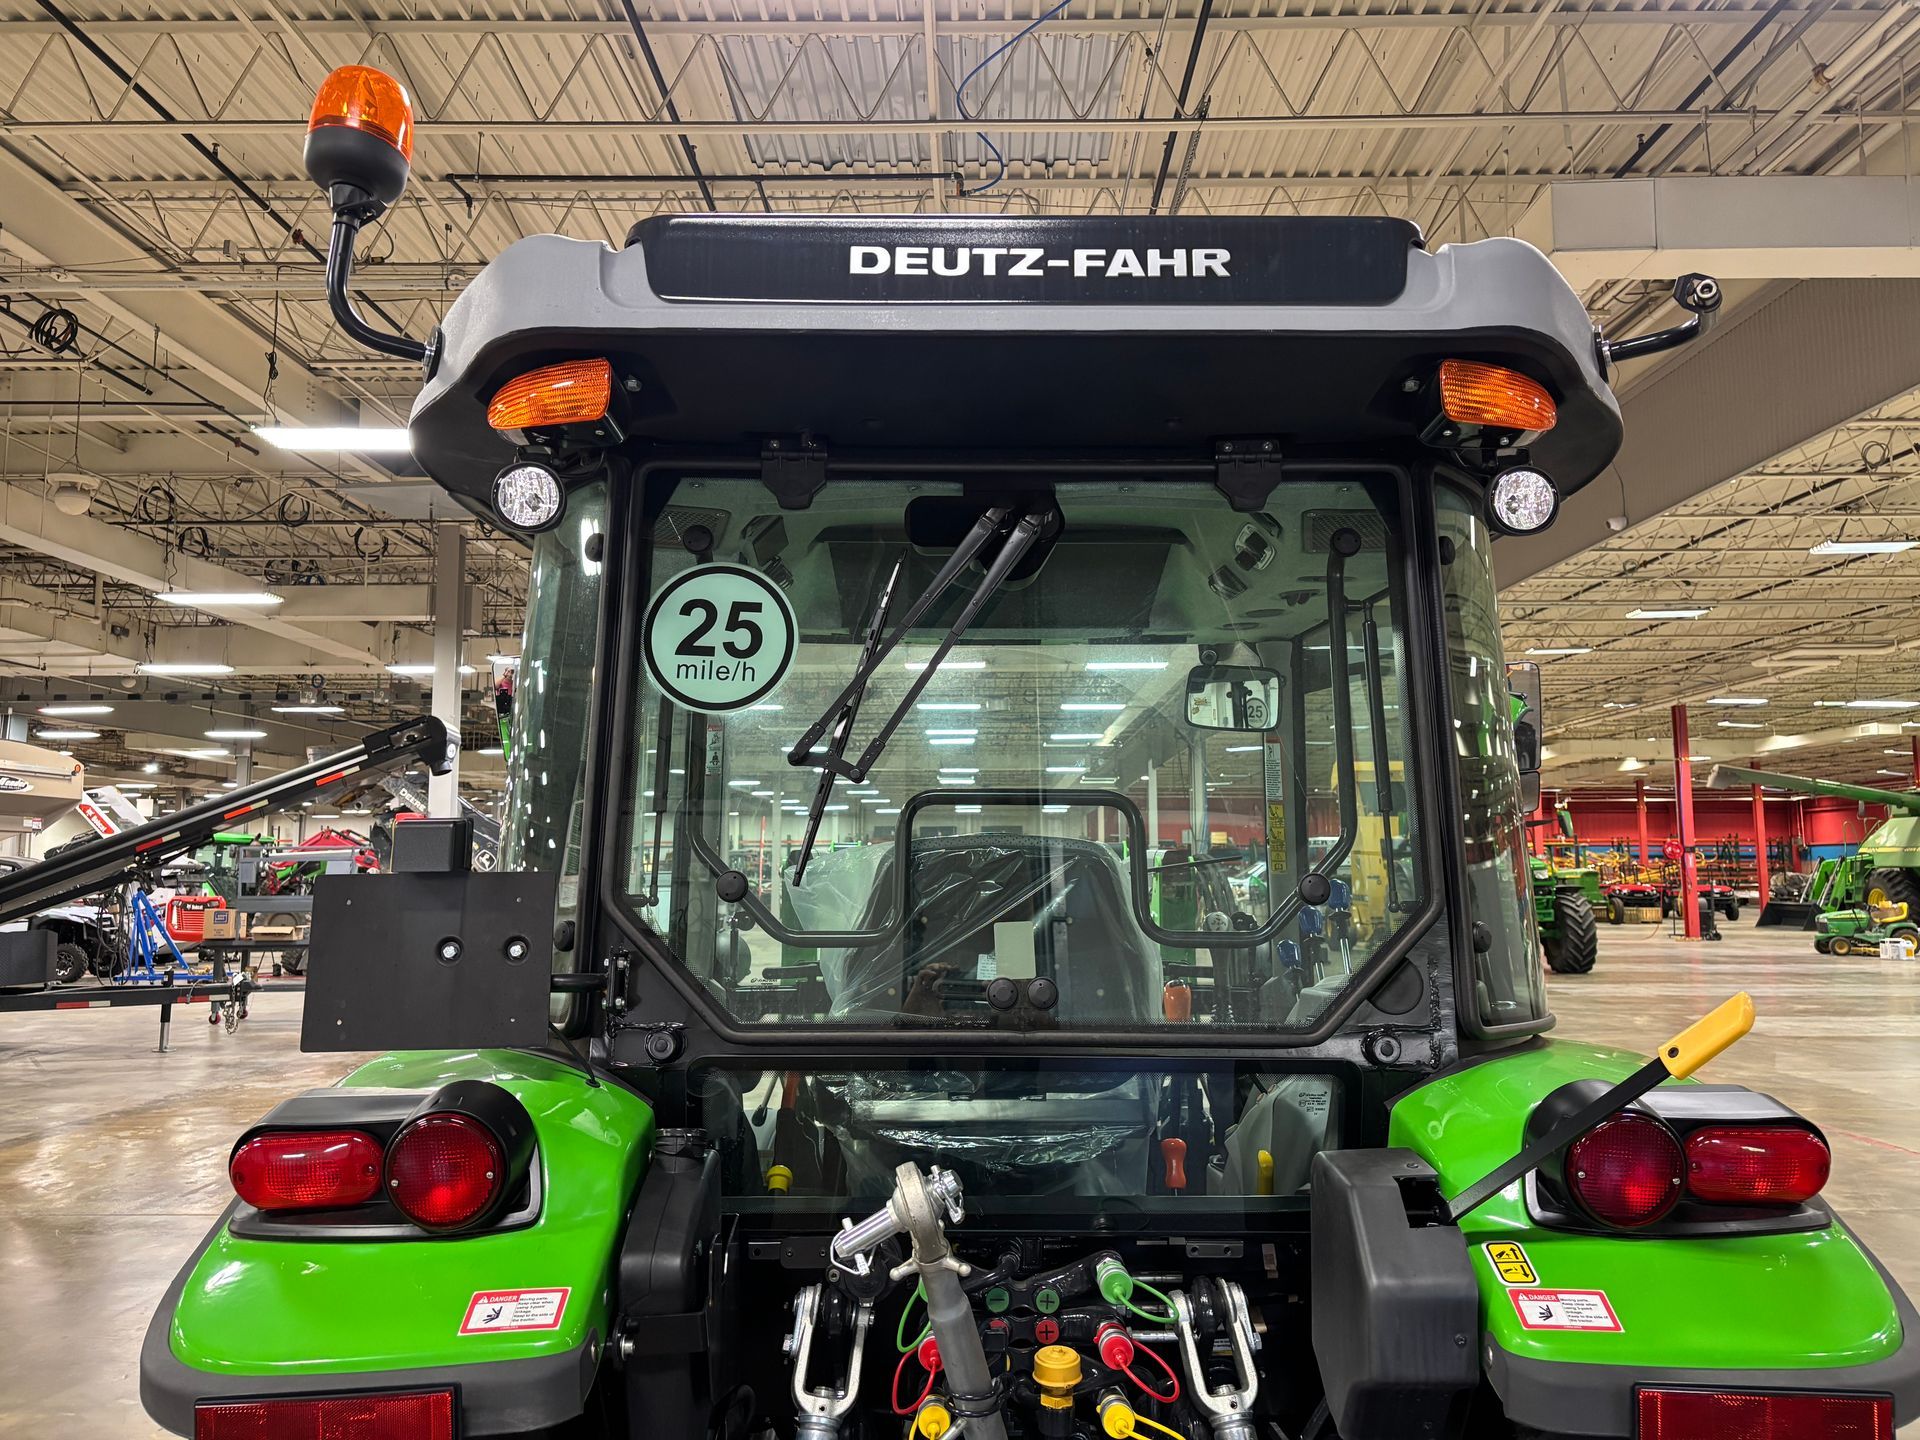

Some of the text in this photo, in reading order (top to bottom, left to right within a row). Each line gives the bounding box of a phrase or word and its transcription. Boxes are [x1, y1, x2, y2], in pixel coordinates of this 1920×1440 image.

[850, 245, 1231, 277] DEUTZ-FAHR
[675, 598, 763, 659] 25
[676, 659, 756, 682] mile/h
[1248, 705, 1263, 718] 25
[399, 787, 426, 811] DEERE
